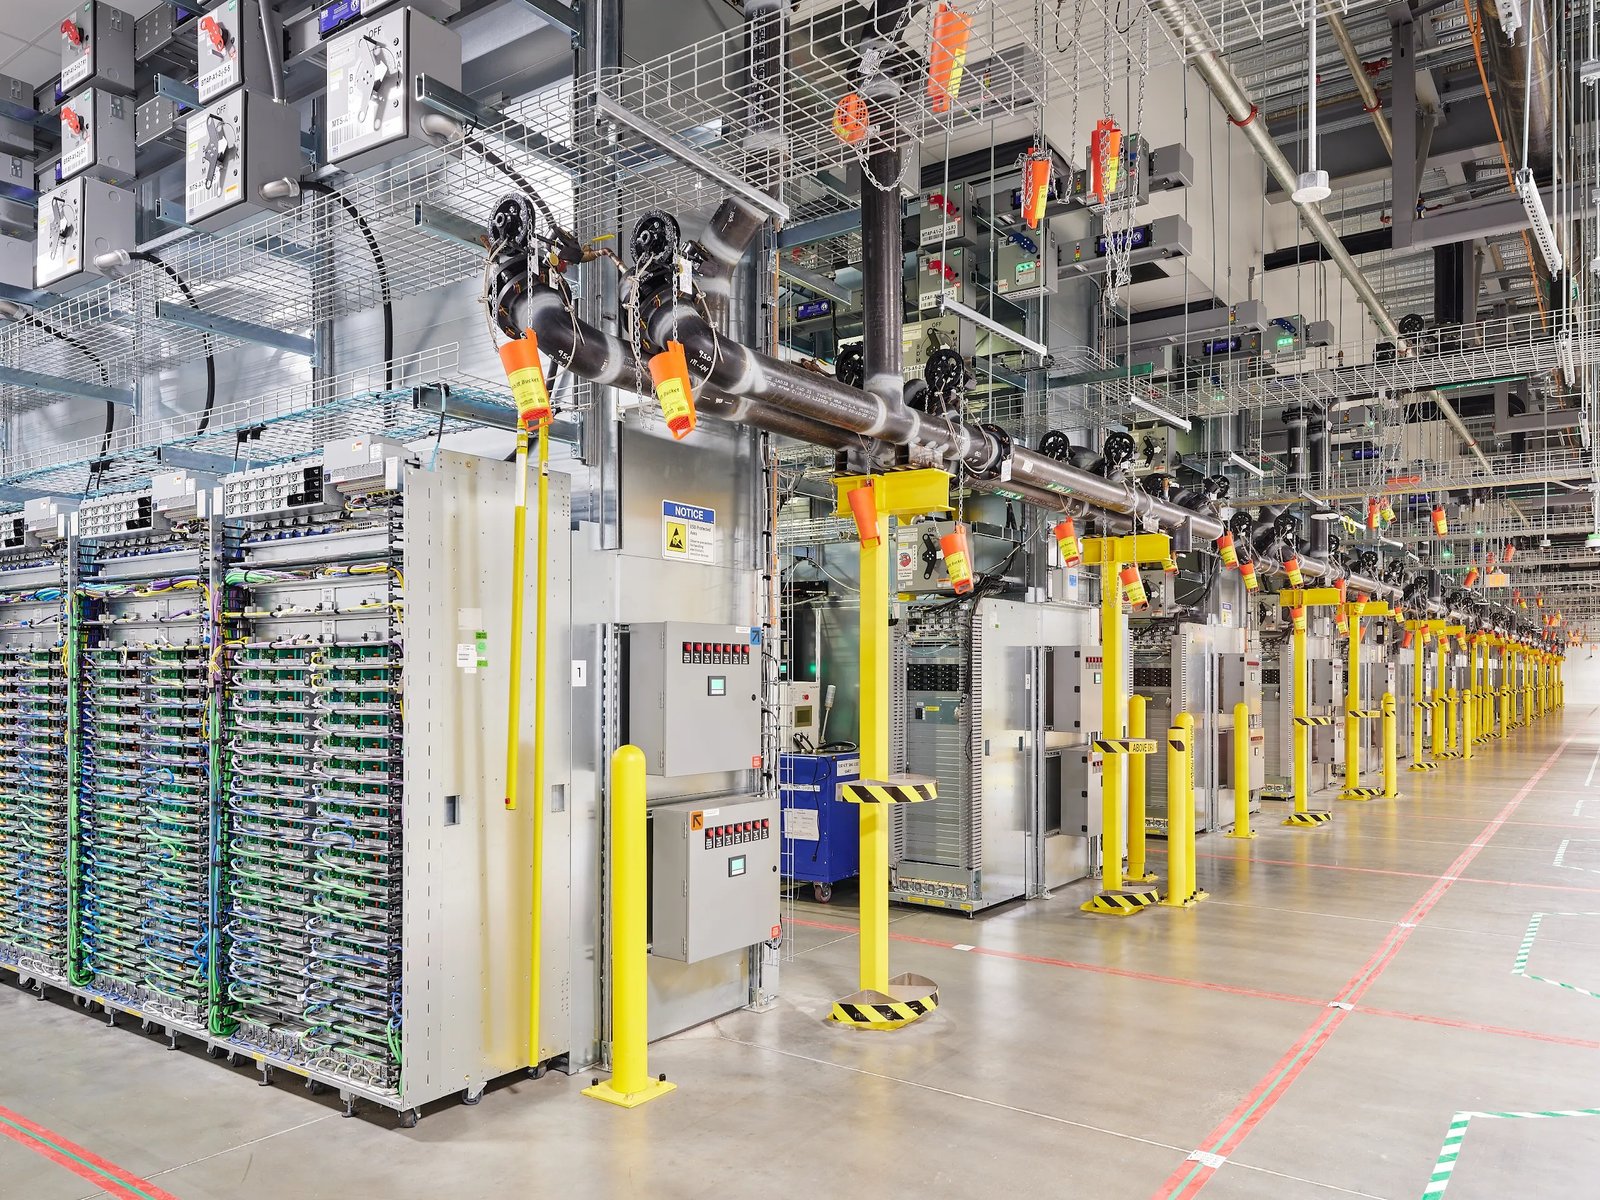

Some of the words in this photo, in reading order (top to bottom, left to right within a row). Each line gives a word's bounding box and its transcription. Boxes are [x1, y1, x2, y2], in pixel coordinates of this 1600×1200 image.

[368, 26, 382, 38] OFF
[216, 104, 226, 116] OFF
[522, 376, 540, 386] Bucket
[675, 506, 704, 520] NOTICE
[577, 667, 581, 679] 1
[1133, 744, 1147, 752] ABOVE
